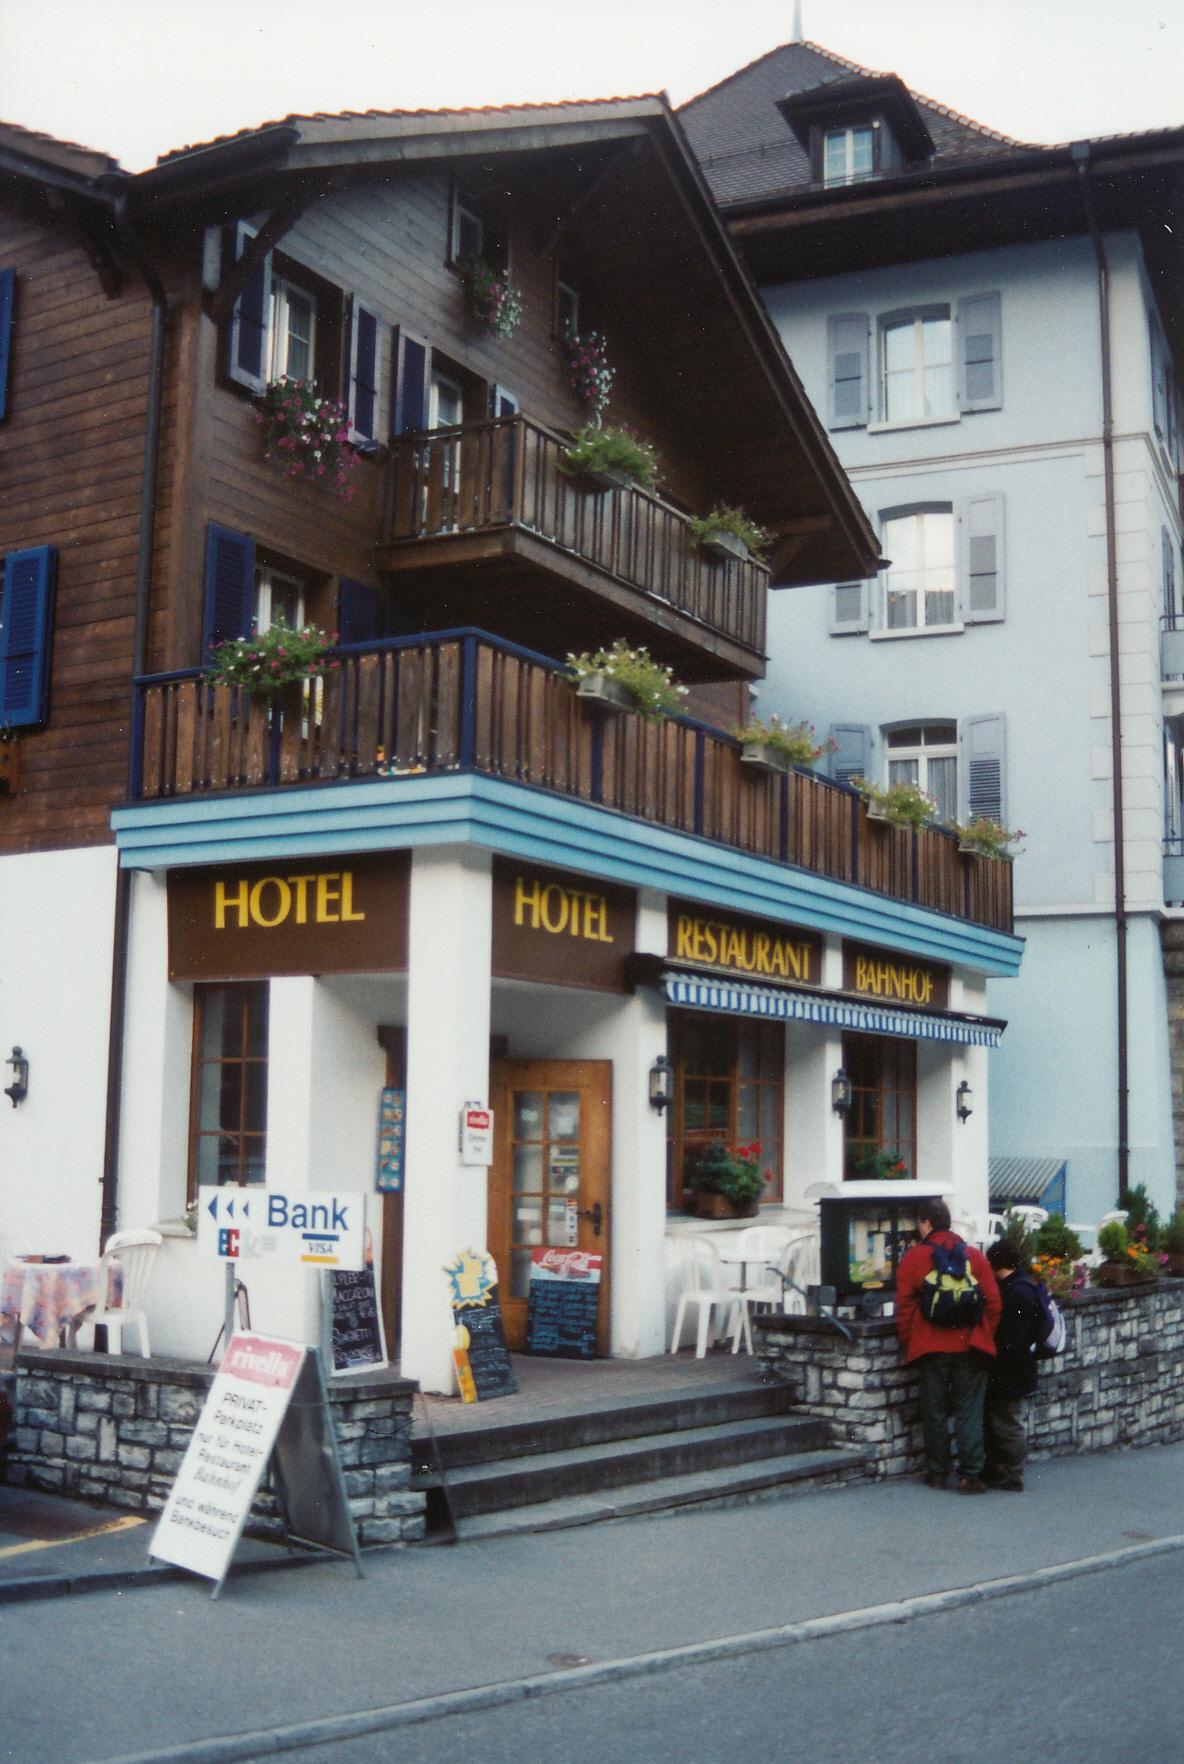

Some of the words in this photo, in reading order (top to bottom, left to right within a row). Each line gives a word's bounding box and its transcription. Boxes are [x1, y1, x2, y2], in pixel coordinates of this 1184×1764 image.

[214, 873, 365, 929] HOTEL
[514, 876, 614, 944] HOTEL
[676, 915, 812, 980] RESTAURANT
[855, 955, 934, 1004] BAHNHOF
[268, 1194, 350, 1231] Bank
[308, 1242, 334, 1254] VISA
[230, 1345, 289, 1378] rivella
[222, 1391, 268, 1412] PRIVAT-
[214, 1408, 263, 1435] Parkplatz
[198, 1446, 252, 1475] Restaurant
